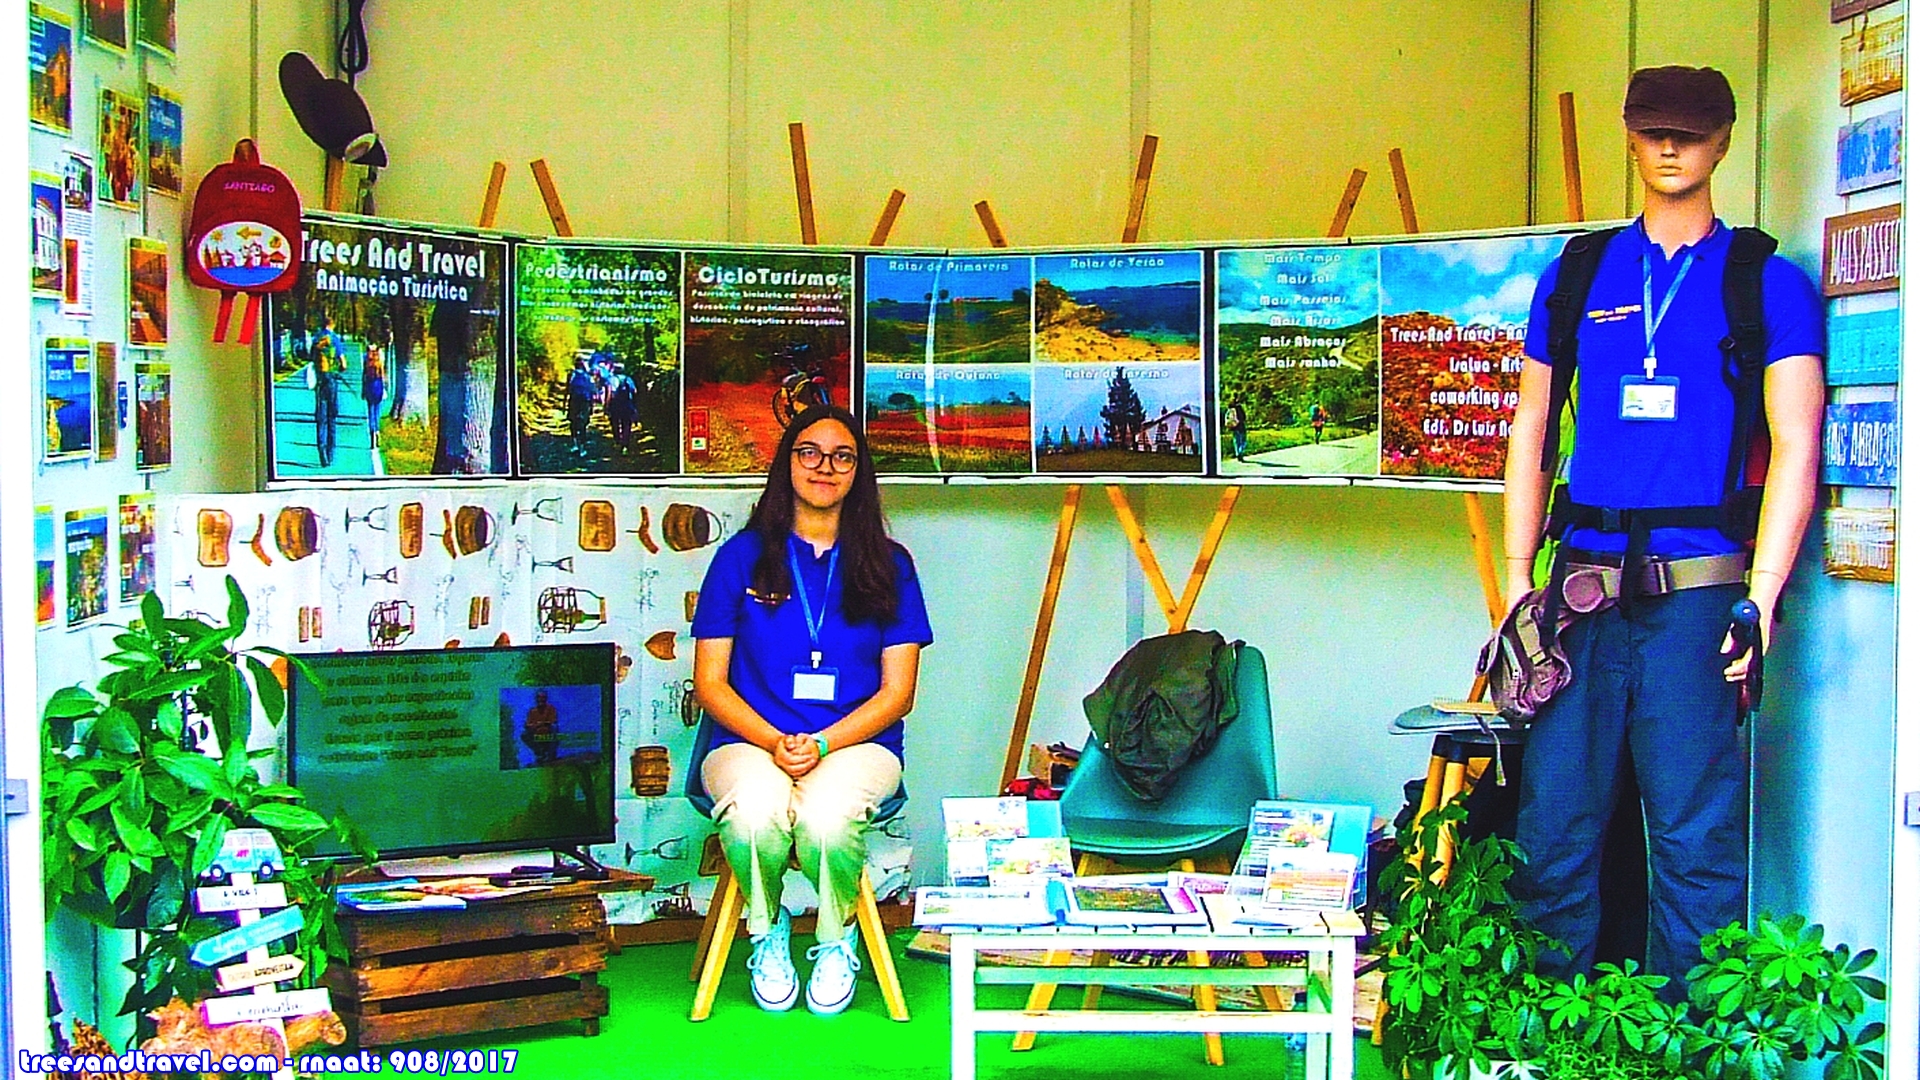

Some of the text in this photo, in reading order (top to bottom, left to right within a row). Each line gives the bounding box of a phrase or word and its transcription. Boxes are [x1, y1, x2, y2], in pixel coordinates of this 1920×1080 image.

[301, 231, 486, 279] Trees And Travel
[1264, 252, 1342, 264] Mais Tempo
[1830, 227, 1860, 286] MAIS
[889, 261, 1009, 273] Rotas de Primavera
[1070, 258, 1105, 269] Rotas
[1109, 257, 1124, 268] de
[526, 262, 667, 281] Pedestrianismo
[316, 269, 468, 301] Animação Turística
[1276, 273, 1330, 285] Mais Sol
[1259, 293, 1346, 306] Mais Passeios
[1269, 315, 1301, 326] Mais
[1390, 327, 1424, 342] Trees
[1427, 326, 1453, 342] And
[1455, 326, 1496, 343] Travel
[1259, 336, 1346, 349] Mais Abraços
[1265, 357, 1342, 369] Mais sonhos
[954, 369, 1001, 382] Outono
[1064, 367, 1170, 379] Rotas de Inverno
[1430, 385, 1499, 410] coworking
[1453, 419, 1470, 436] Dr
